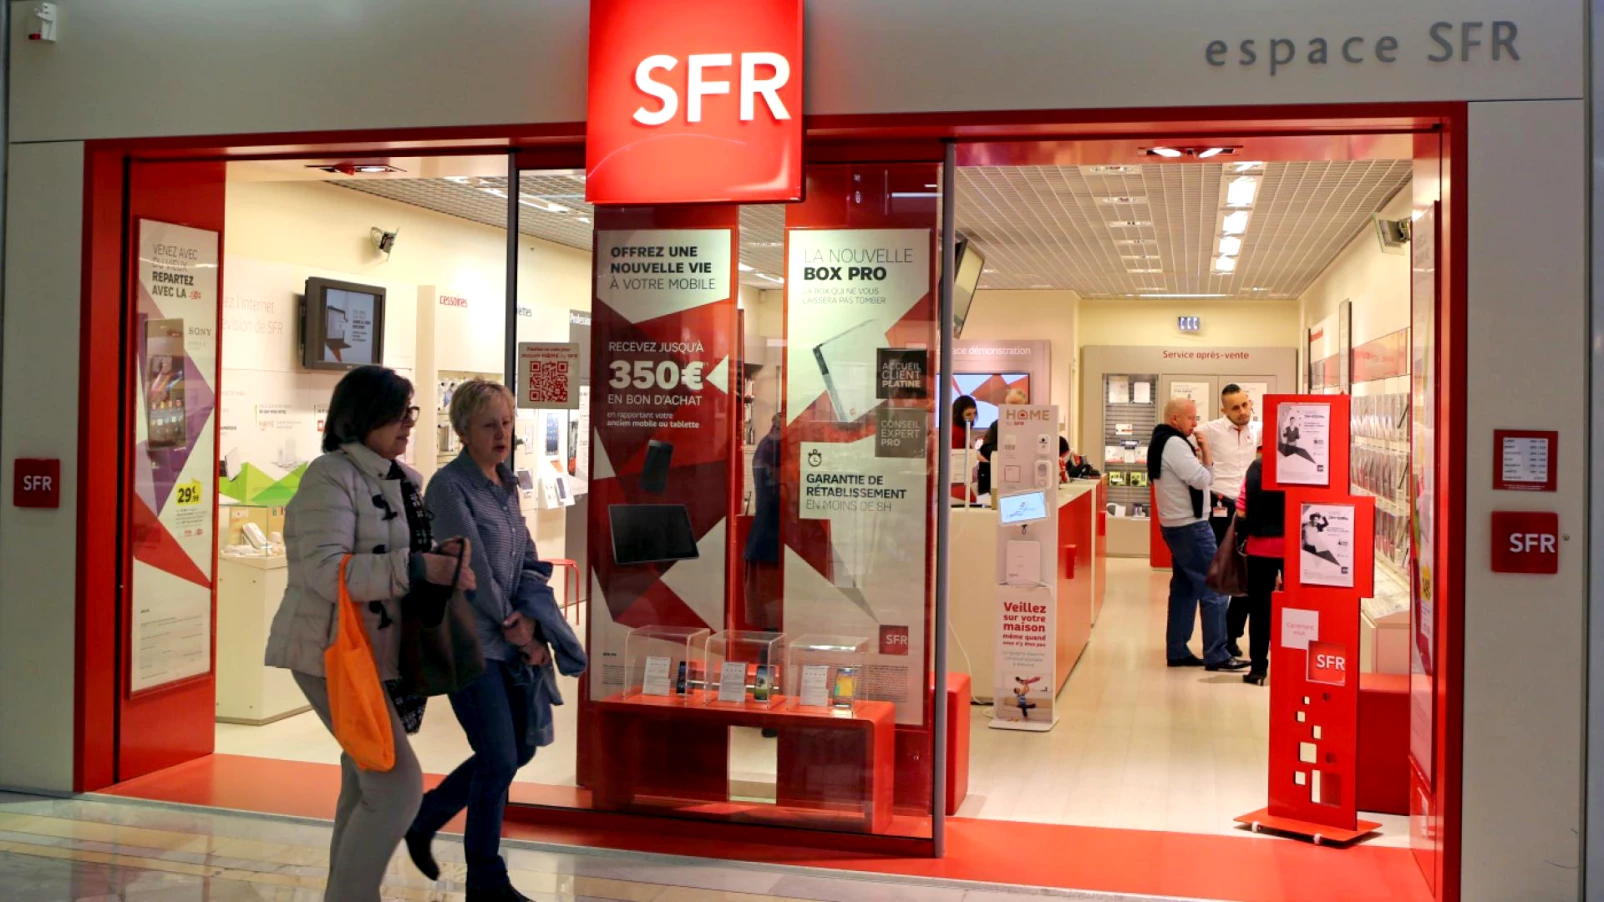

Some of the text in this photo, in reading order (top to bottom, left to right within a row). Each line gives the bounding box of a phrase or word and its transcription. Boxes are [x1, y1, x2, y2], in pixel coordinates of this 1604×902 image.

[1205, 20, 1520, 77] espace SFR
[633, 51, 791, 126] SFR
[152, 243, 198, 260] VENEZ AVEC
[611, 246, 698, 258] OFFREZ UNE
[804, 248, 913, 263] LA NOUVELLE
[611, 262, 712, 273] NOUVELLE VIE
[804, 266, 887, 280] BOX PRO
[152, 271, 194, 286] REPARTEZ
[610, 276, 715, 289] À VOTRE MOBILE
[152, 285, 173, 298] AVEC
[176, 288, 187, 298] LA
[859, 287, 879, 295] VOUS
[188, 327, 212, 337] SONY
[608, 340, 704, 354] RECEVEZ JUSQU'À
[968, 345, 1031, 356] démonstration
[1163, 350, 1249, 361] Service après-vente
[882, 362, 921, 371] ACCUEIL
[609, 360, 704, 391] 350€
[882, 371, 920, 380] CLIENT
[882, 380, 921, 388] PLATINE
[608, 394, 702, 406] EN BON D'ACHAT
[617, 412, 653, 420] rapportant
[1006, 409, 1050, 421] HOME
[632, 420, 657, 428] mobile
[670, 421, 700, 429] tablette
[881, 420, 920, 429] CONSEIL
[881, 429, 921, 438] EXPERT
[23, 475, 52, 491] SFR
[806, 474, 883, 485] GARANTIE DE
[806, 485, 907, 499] RÉTABLISSEMENT
[806, 499, 821, 510] EN
[823, 500, 857, 511] MOINS
[860, 502, 874, 512] DE
[1509, 533, 1556, 553] SFR
[1003, 602, 1047, 614] Veillez
[1021, 614, 1046, 622] votre
[1003, 622, 1046, 632] maison
[886, 634, 908, 645] SFR
[1316, 653, 1346, 671] SFR
